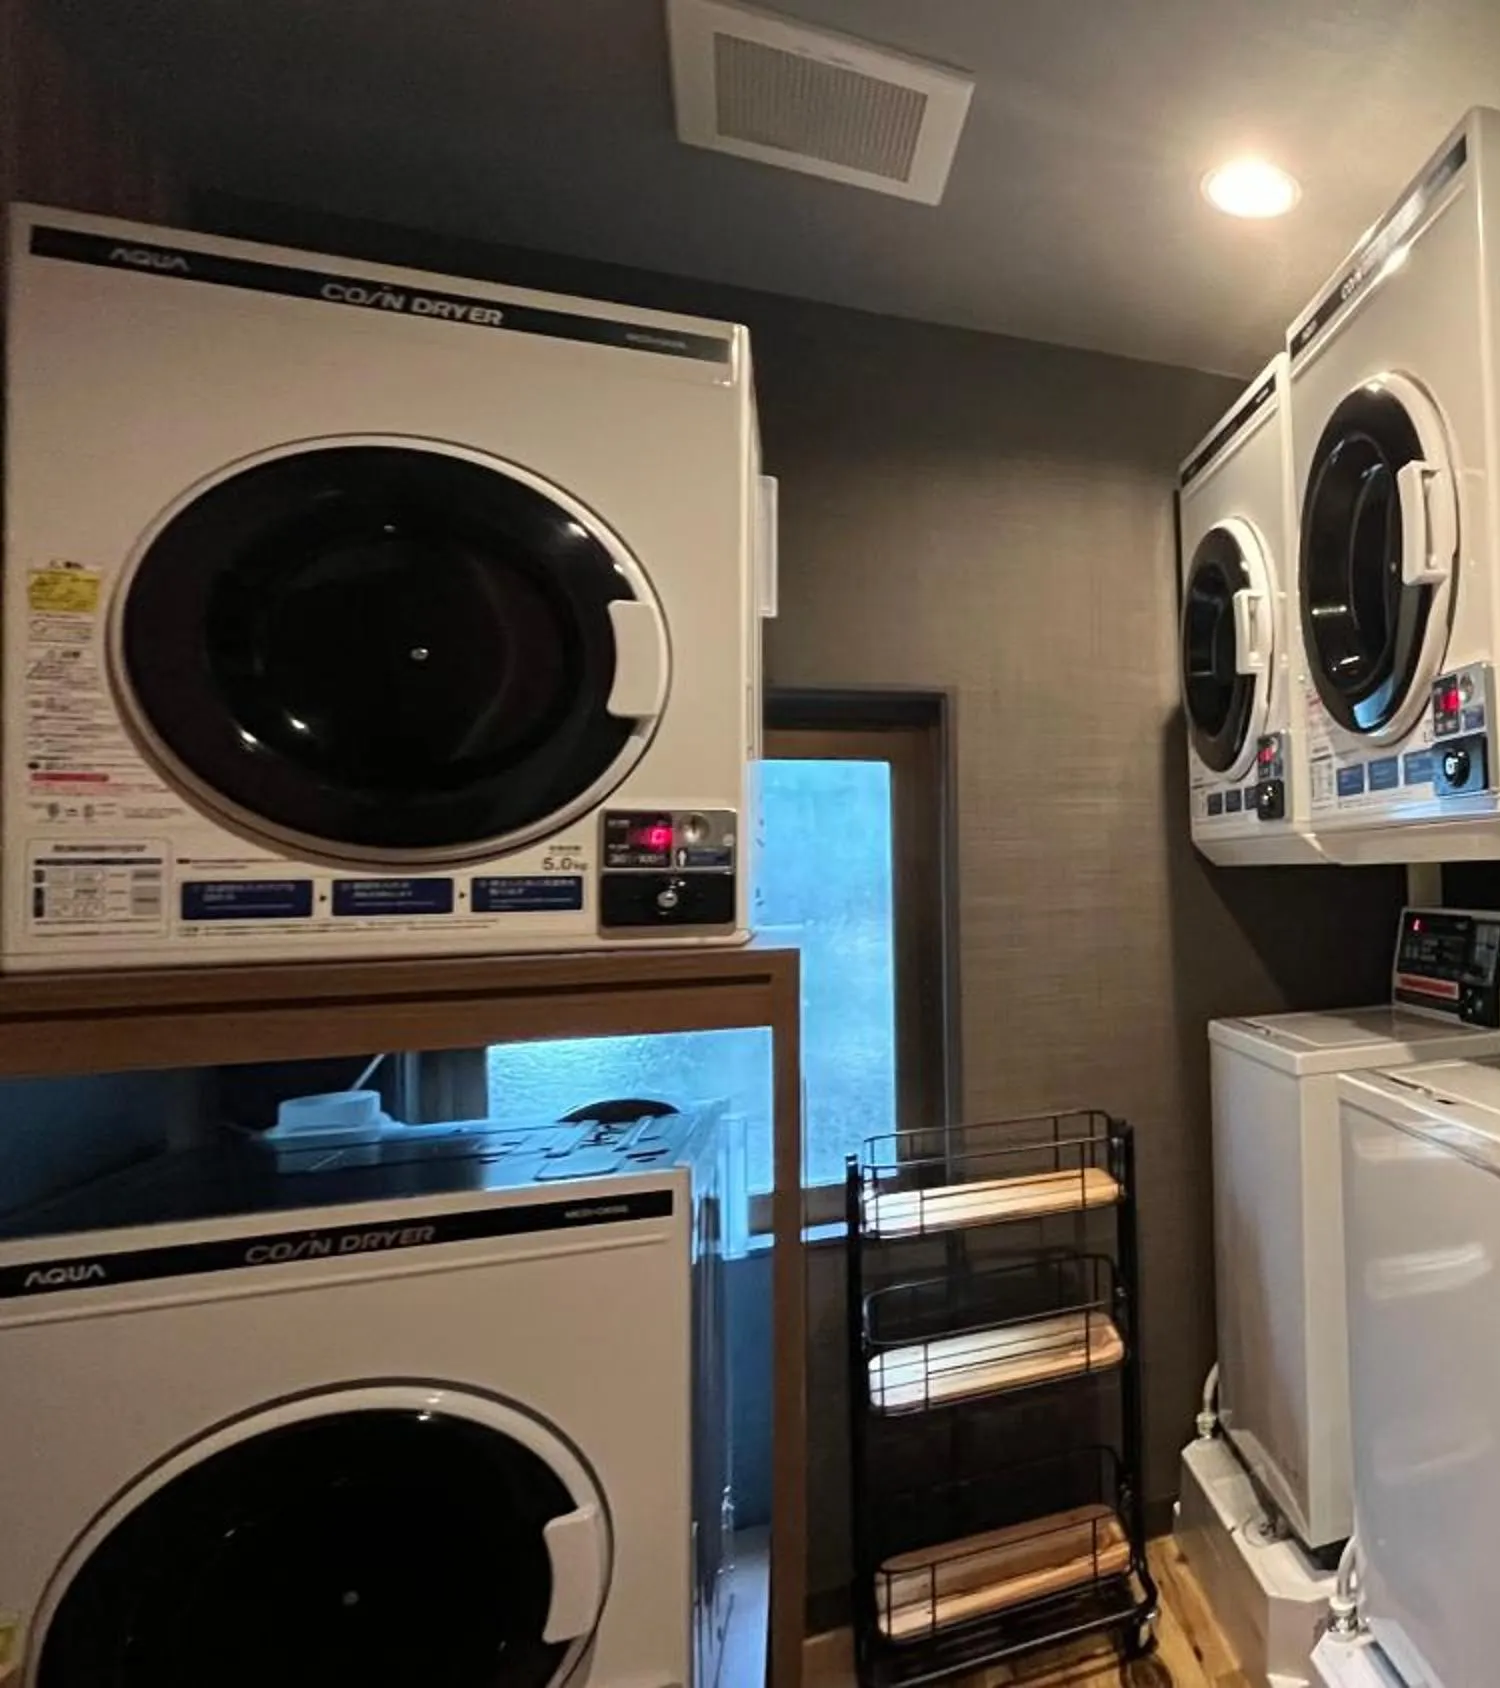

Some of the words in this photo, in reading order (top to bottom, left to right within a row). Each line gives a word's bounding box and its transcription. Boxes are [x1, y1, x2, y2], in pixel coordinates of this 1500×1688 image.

[108, 247, 191, 272] AQUA
[410, 296, 505, 326] DRYER
[338, 1225, 437, 1252] DRYER
[24, 1263, 106, 1289] AQUA
